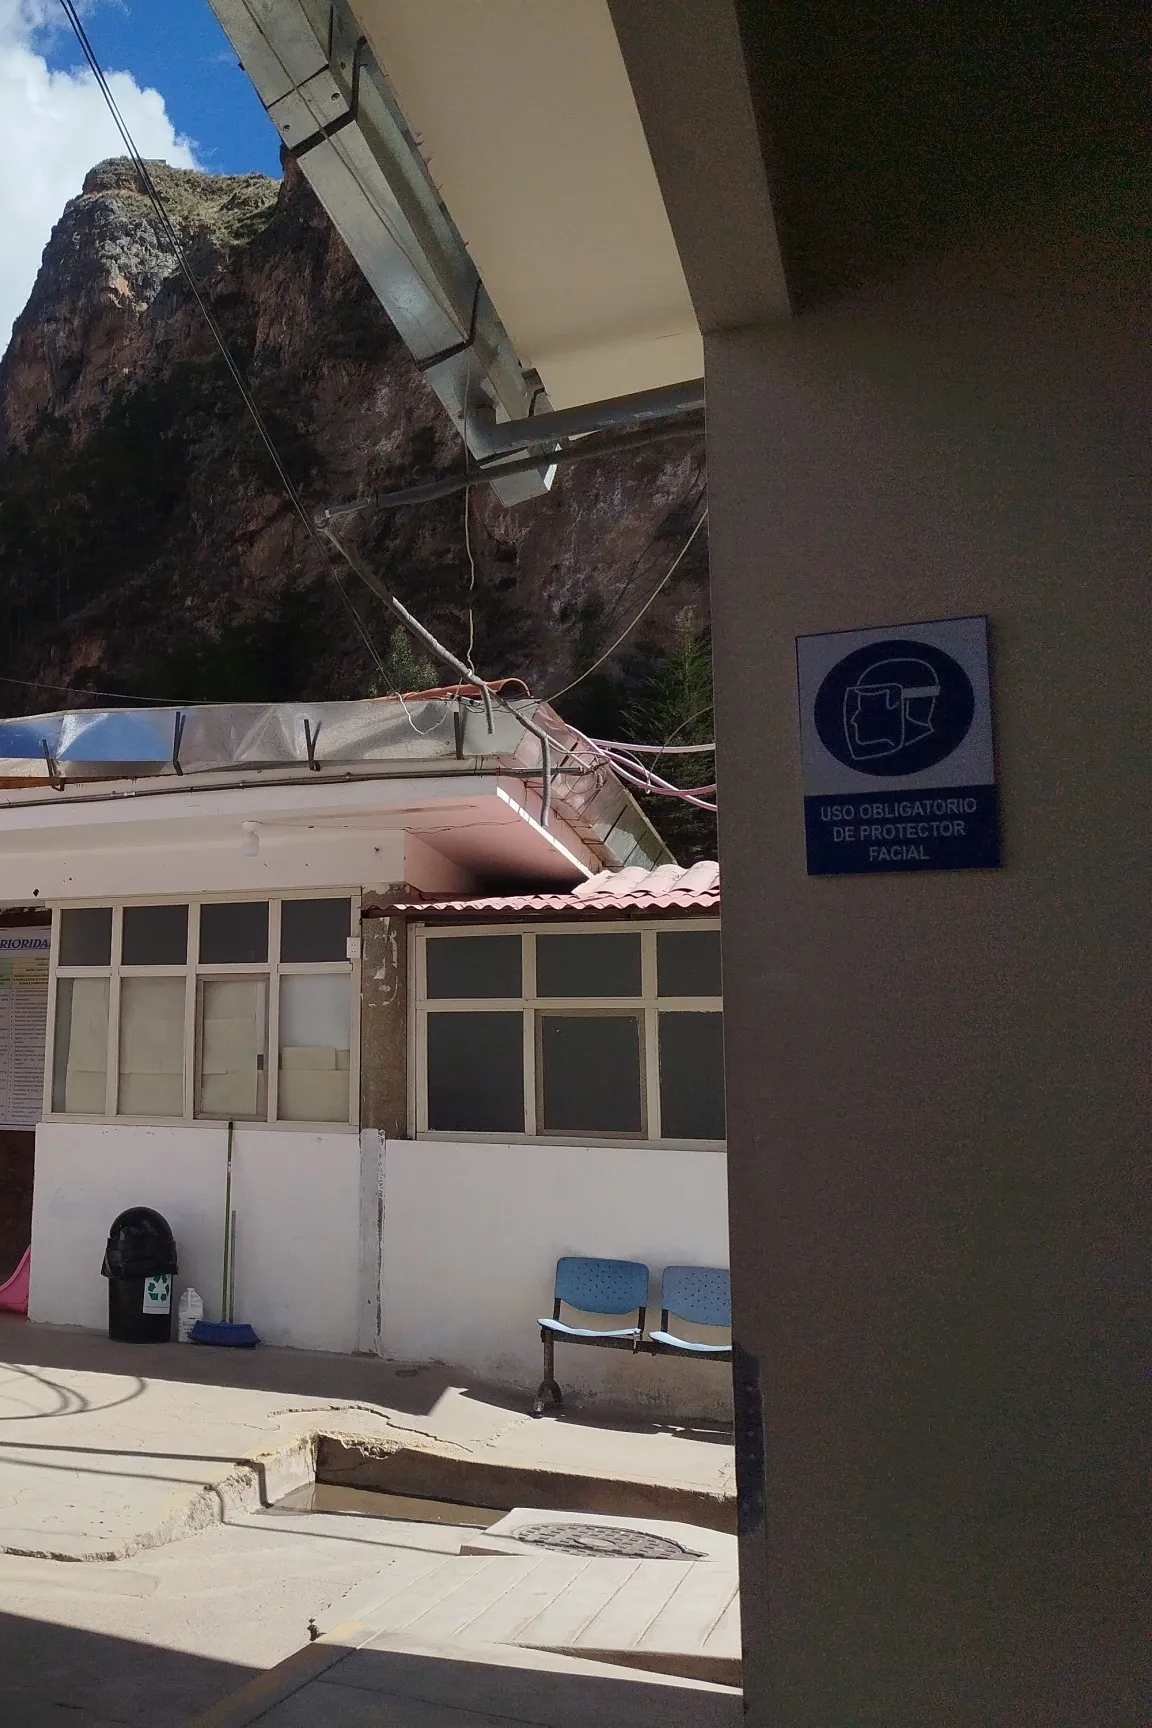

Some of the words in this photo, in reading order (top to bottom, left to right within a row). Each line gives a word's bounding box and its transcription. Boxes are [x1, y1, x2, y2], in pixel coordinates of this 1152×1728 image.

[821, 805, 855, 821] USO
[859, 797, 977, 819] OBLIGATORIO
[833, 825, 857, 842] DE
[861, 820, 966, 840] PROTECTOR
[869, 846, 930, 862] FACIAL
